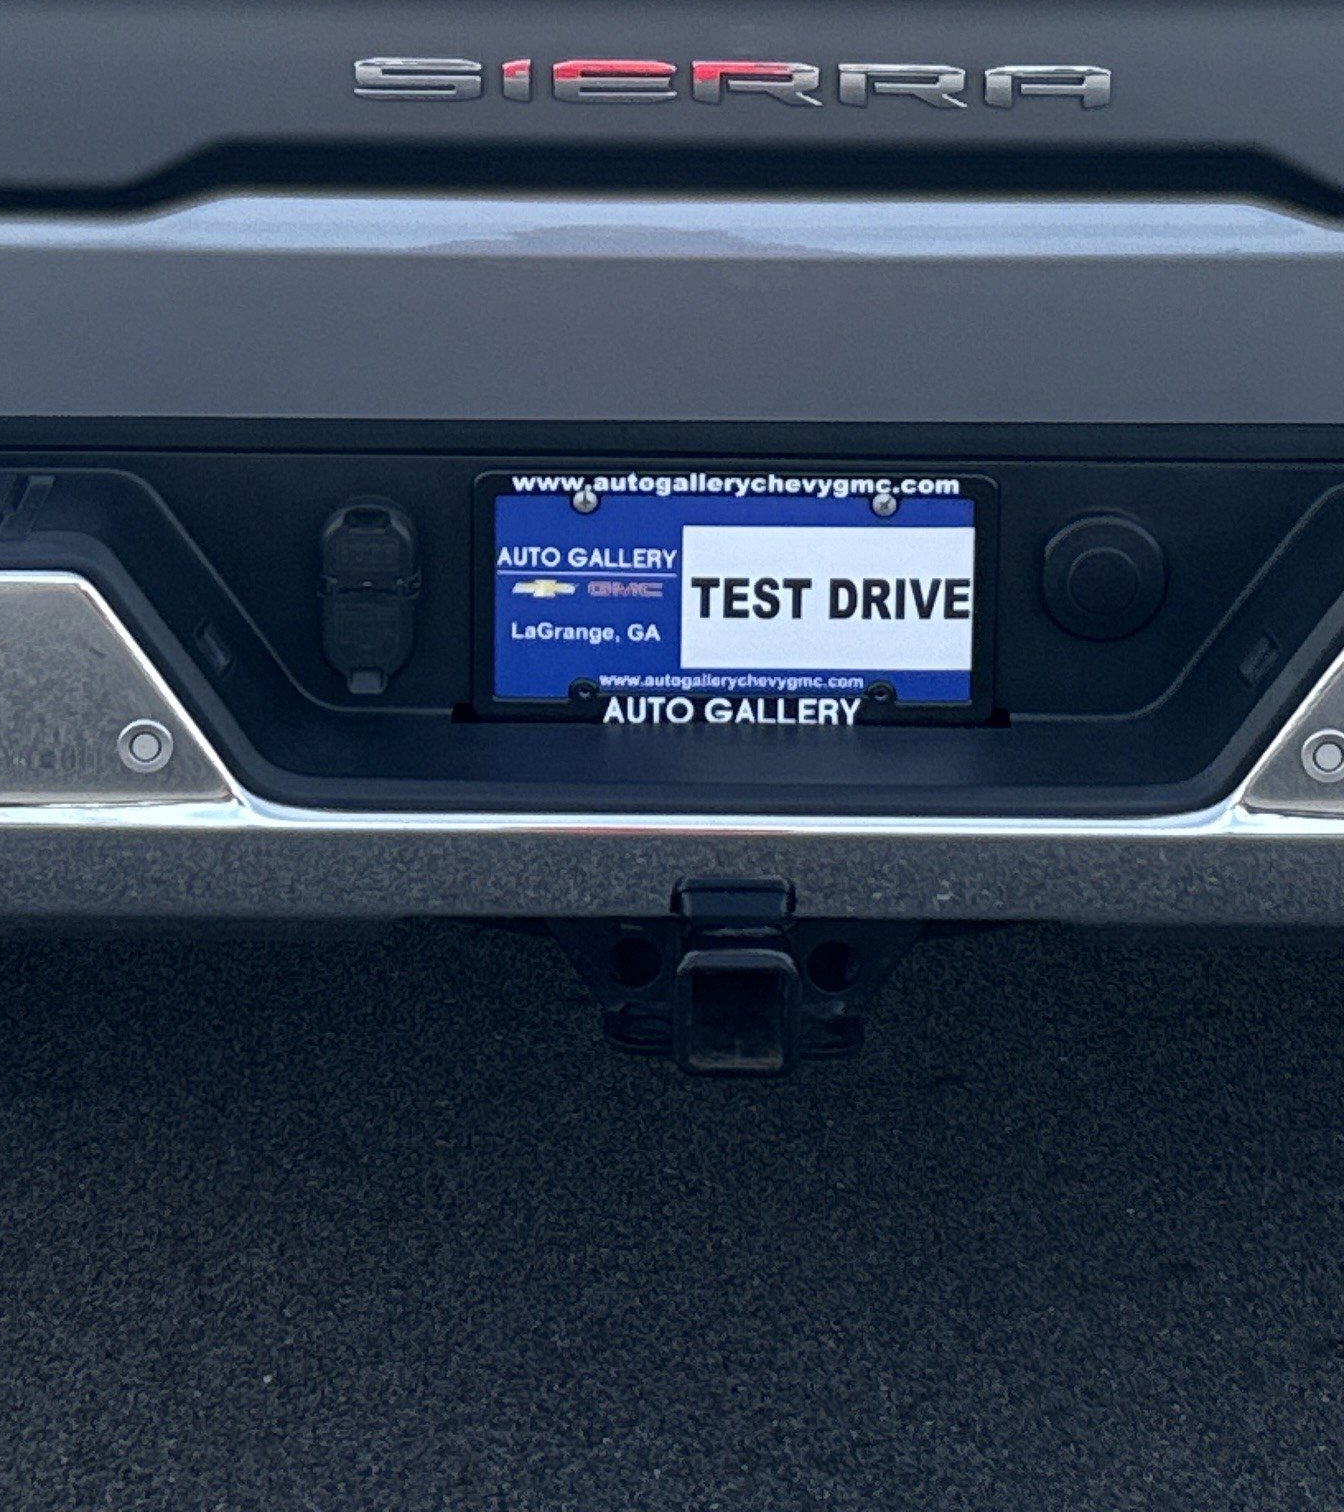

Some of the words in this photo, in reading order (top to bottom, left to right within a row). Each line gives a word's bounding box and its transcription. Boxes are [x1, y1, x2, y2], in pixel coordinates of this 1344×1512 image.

[354, 58, 1113, 108] SIERRA
[511, 472, 960, 497] www.autogallerychevygmc.com
[497, 546, 561, 568] AUTO
[567, 547, 678, 569] GALLERY
[587, 581, 664, 597] GMC
[691, 577, 812, 619] TEST
[828, 578, 971, 619] DRIVE
[511, 621, 621, 645] LaGrange,
[627, 624, 661, 642] GA
[599, 673, 864, 691] www.autogallerychevygmc.com
[602, 696, 695, 724] AUTO
[704, 697, 862, 726] GALLERY
